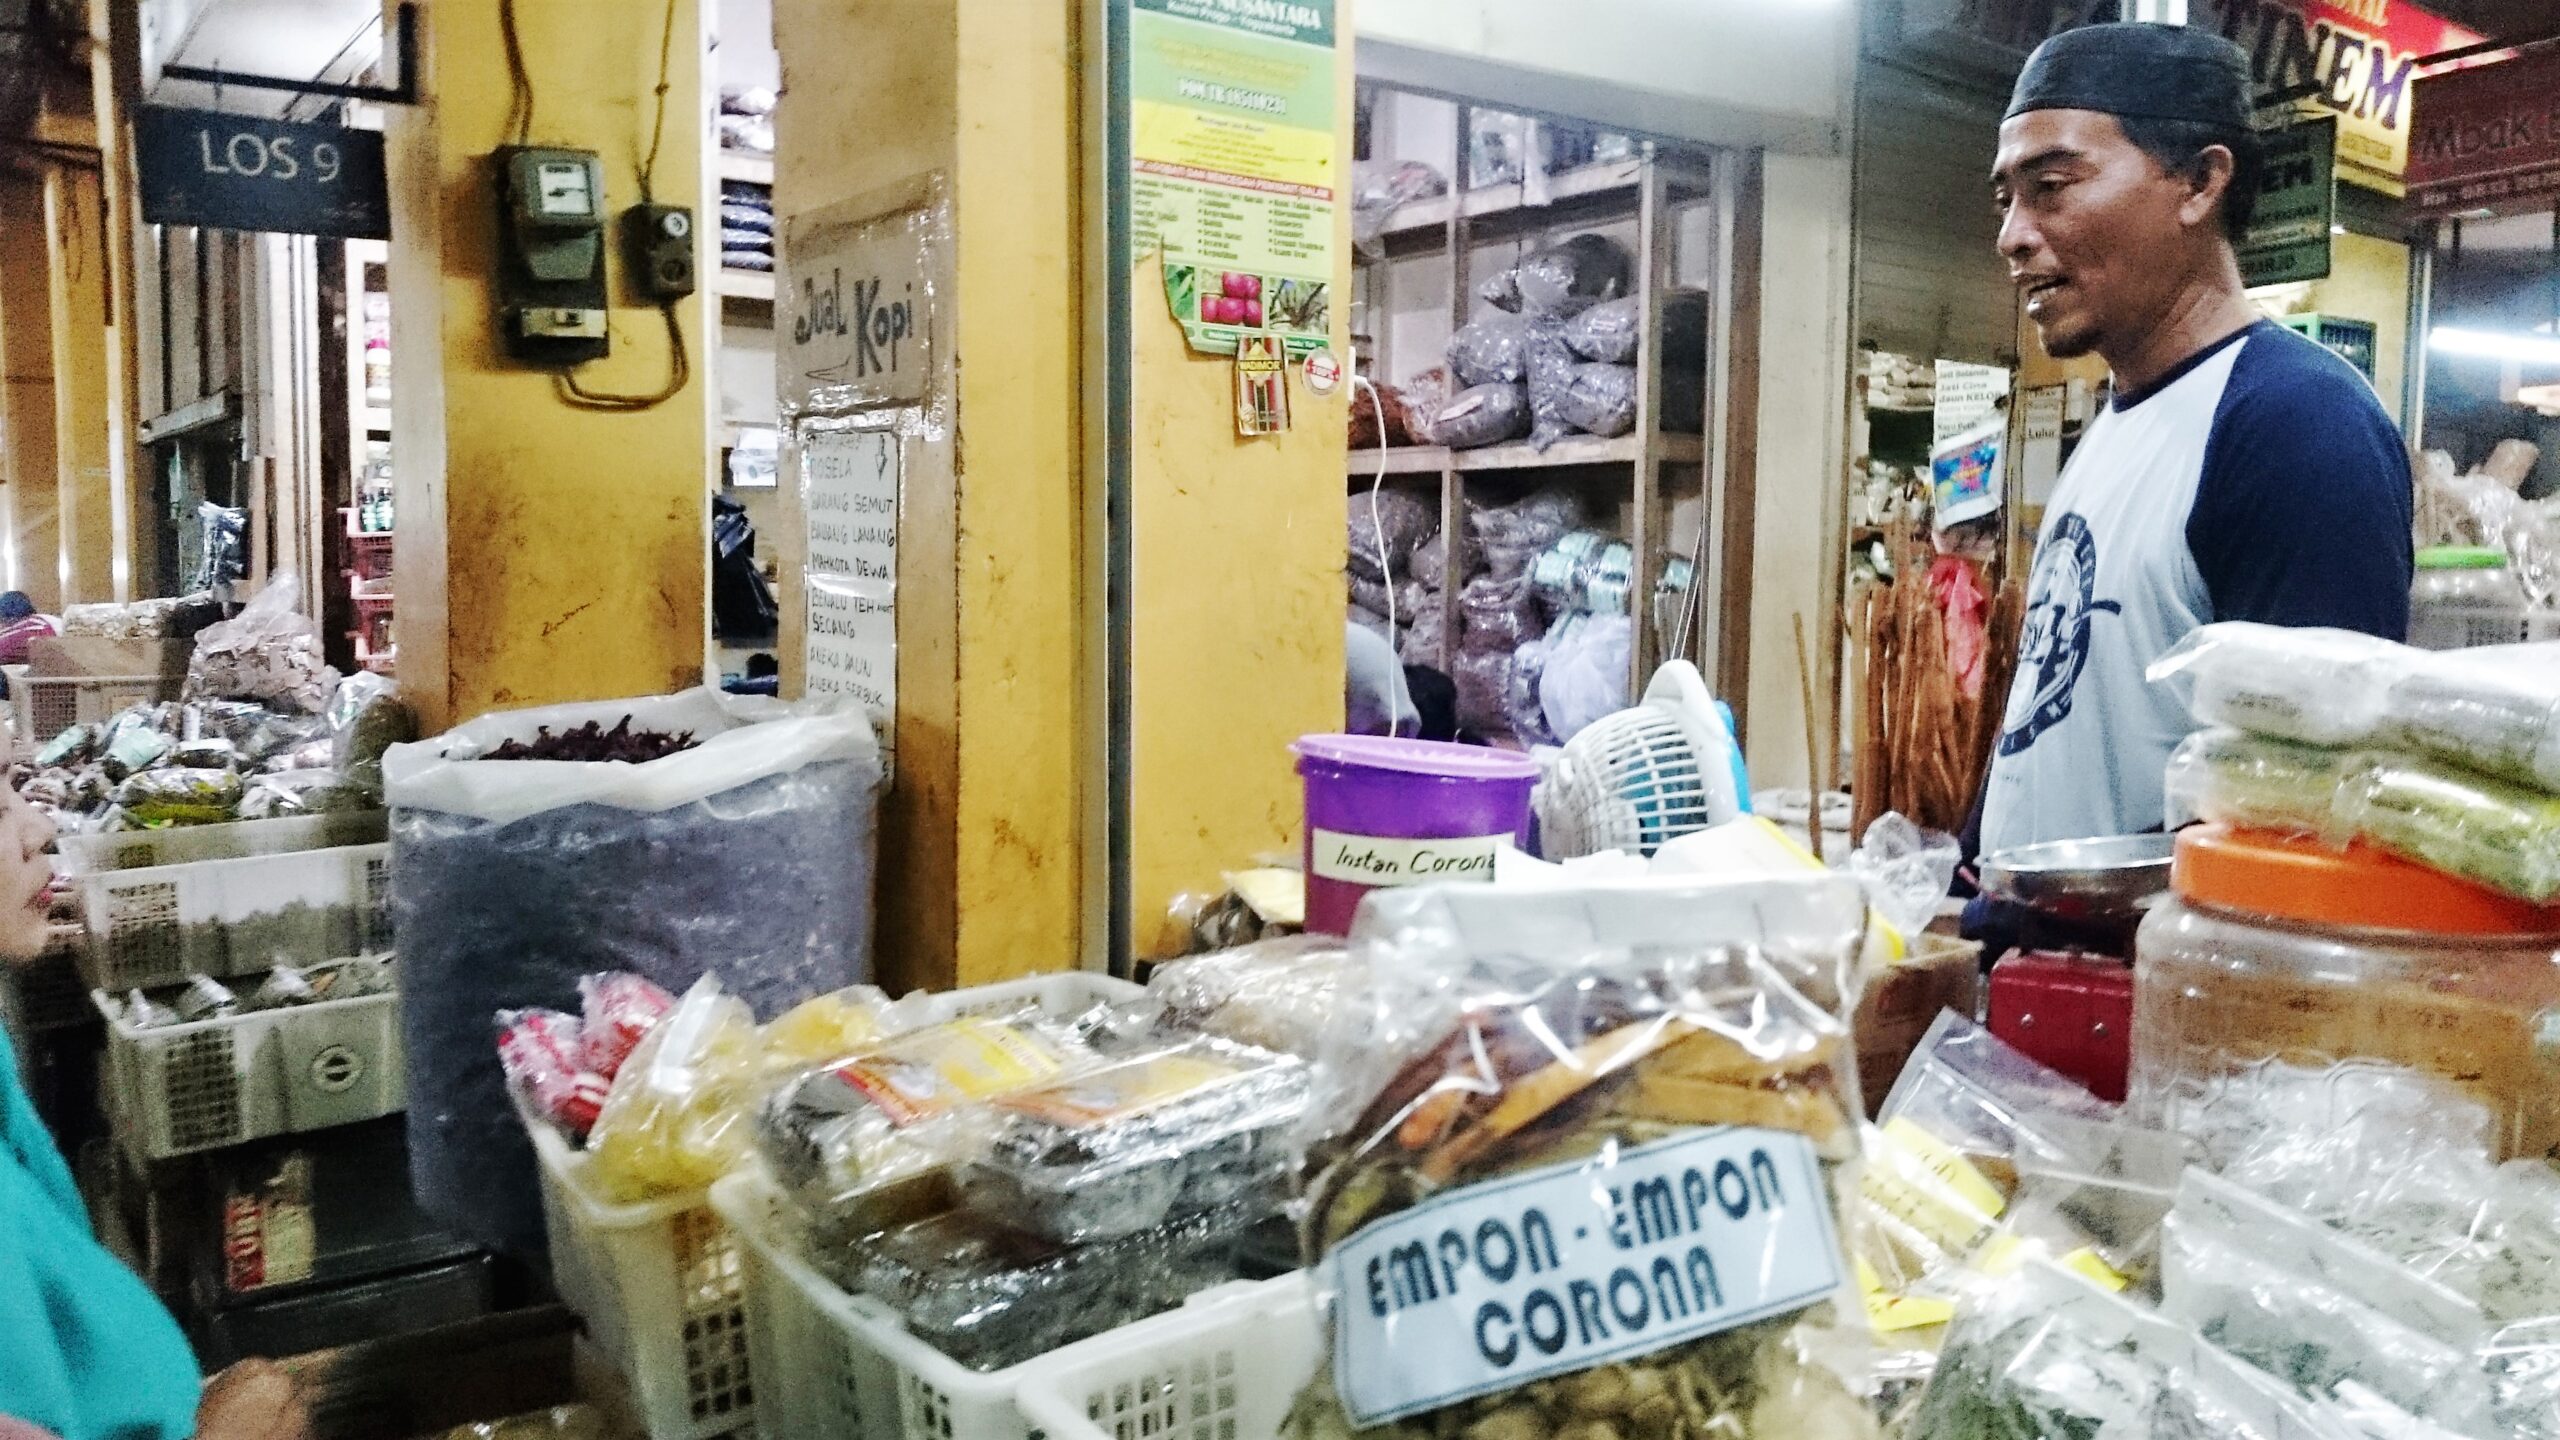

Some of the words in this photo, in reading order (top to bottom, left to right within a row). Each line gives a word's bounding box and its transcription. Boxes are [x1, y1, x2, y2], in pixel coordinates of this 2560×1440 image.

[200, 129, 298, 180] LOS
[313, 143, 340, 183] 9
[854, 275, 913, 378] Kopi
[1239, 360, 1281, 372] WADIMOR
[855, 492, 894, 515] SEMUT
[853, 526, 896, 548] LANANG
[811, 552, 852, 575] MAHKOTA
[855, 556, 889, 580] DEWA
[811, 586, 848, 611] BENALU
[853, 597, 875, 614] TEH
[812, 611, 856, 639] SECANG
[810, 645, 840, 679] ANEKA
[809, 674, 840, 694] ANEKA
[1336, 843, 1400, 875] Instan
[1366, 1206, 1560, 1318] EMPON
[1606, 1147, 1782, 1250] EMPON
[1475, 1244, 1725, 1368] CORONA
